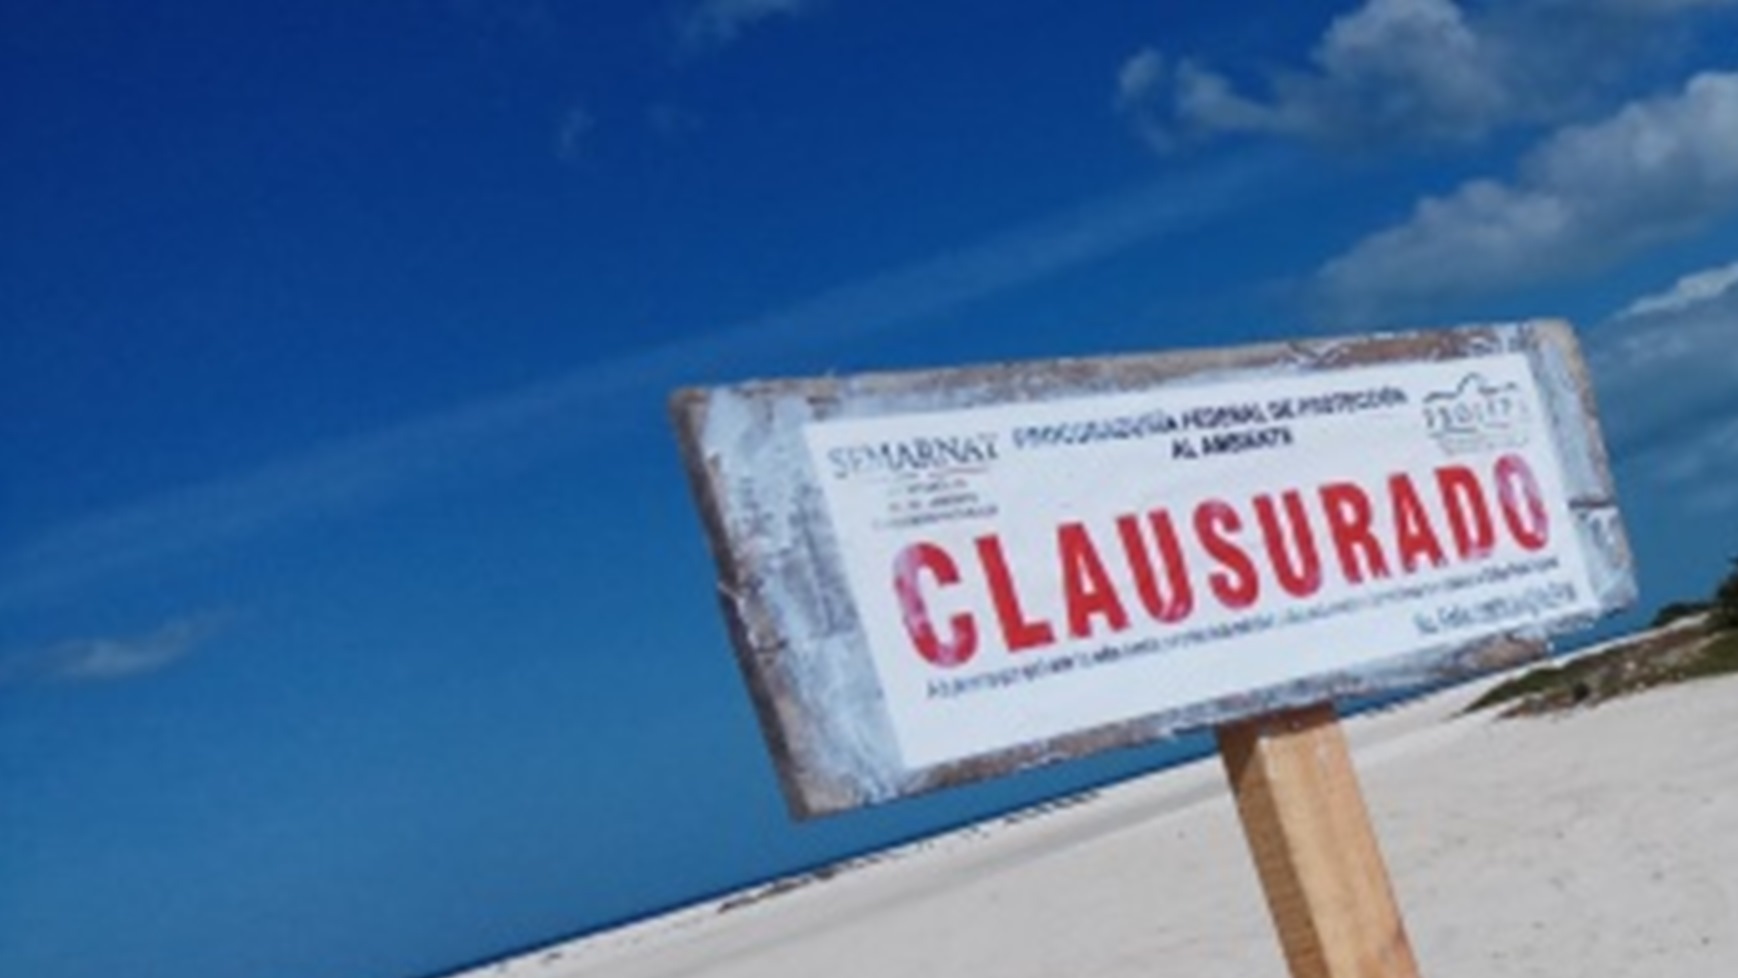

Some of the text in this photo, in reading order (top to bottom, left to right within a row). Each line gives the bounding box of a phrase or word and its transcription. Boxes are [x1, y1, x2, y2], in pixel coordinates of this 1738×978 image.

[1182, 400, 1266, 429] FEDERAL
[1269, 397, 1294, 420] DE
[827, 431, 1000, 480] SEMARNAT
[1172, 425, 1294, 459] AL AMBIENTE
[892, 453, 1550, 668] CLAUSURADO
